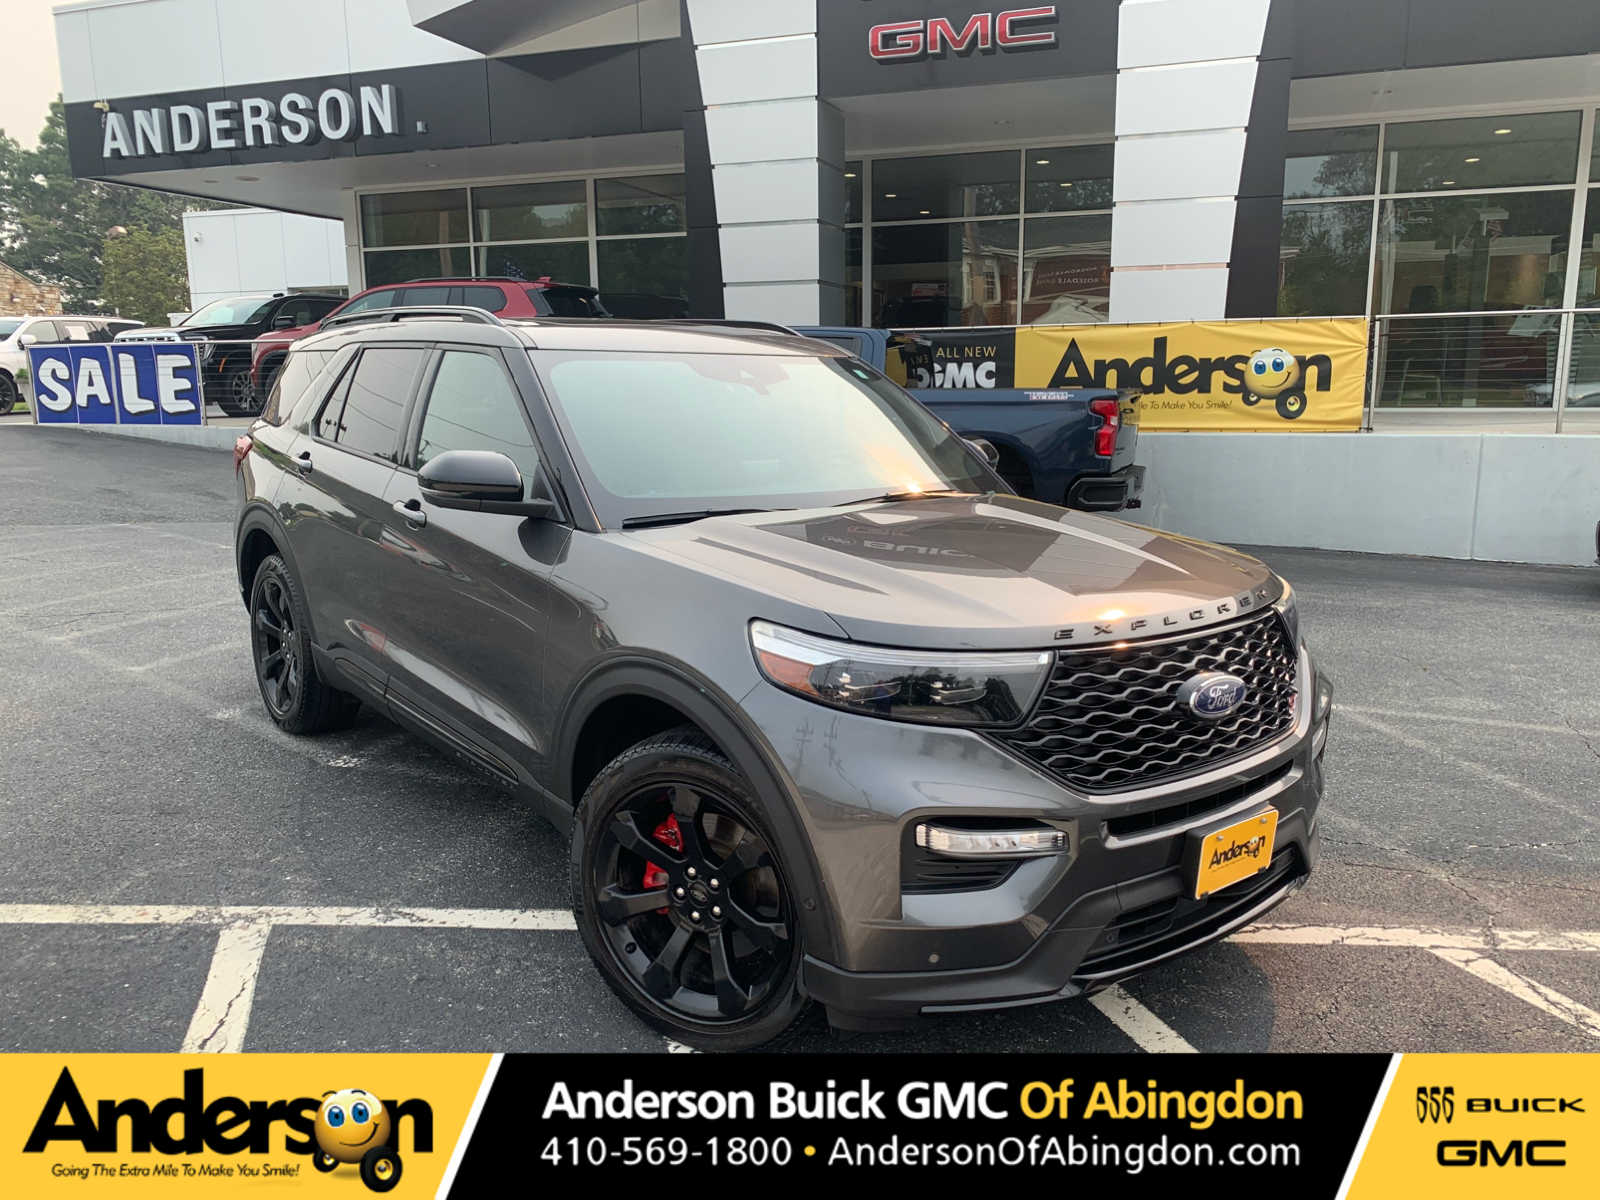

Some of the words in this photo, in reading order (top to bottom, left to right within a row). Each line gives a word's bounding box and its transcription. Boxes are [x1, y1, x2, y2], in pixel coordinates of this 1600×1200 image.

[868, 5, 1056, 60] GMC
[102, 84, 397, 158] ANDERSON
[936, 346, 960, 358] ALL
[964, 346, 996, 358] NEW
[38, 352, 196, 414] SALE
[1150, 400, 1160, 409] To
[1161, 400, 1186, 409] Make
[1188, 400, 1204, 409] You
[1207, 400, 1233, 409] Smile!
[1053, 588, 1269, 641] EXPLORER
[1206, 684, 1240, 710] Ford
